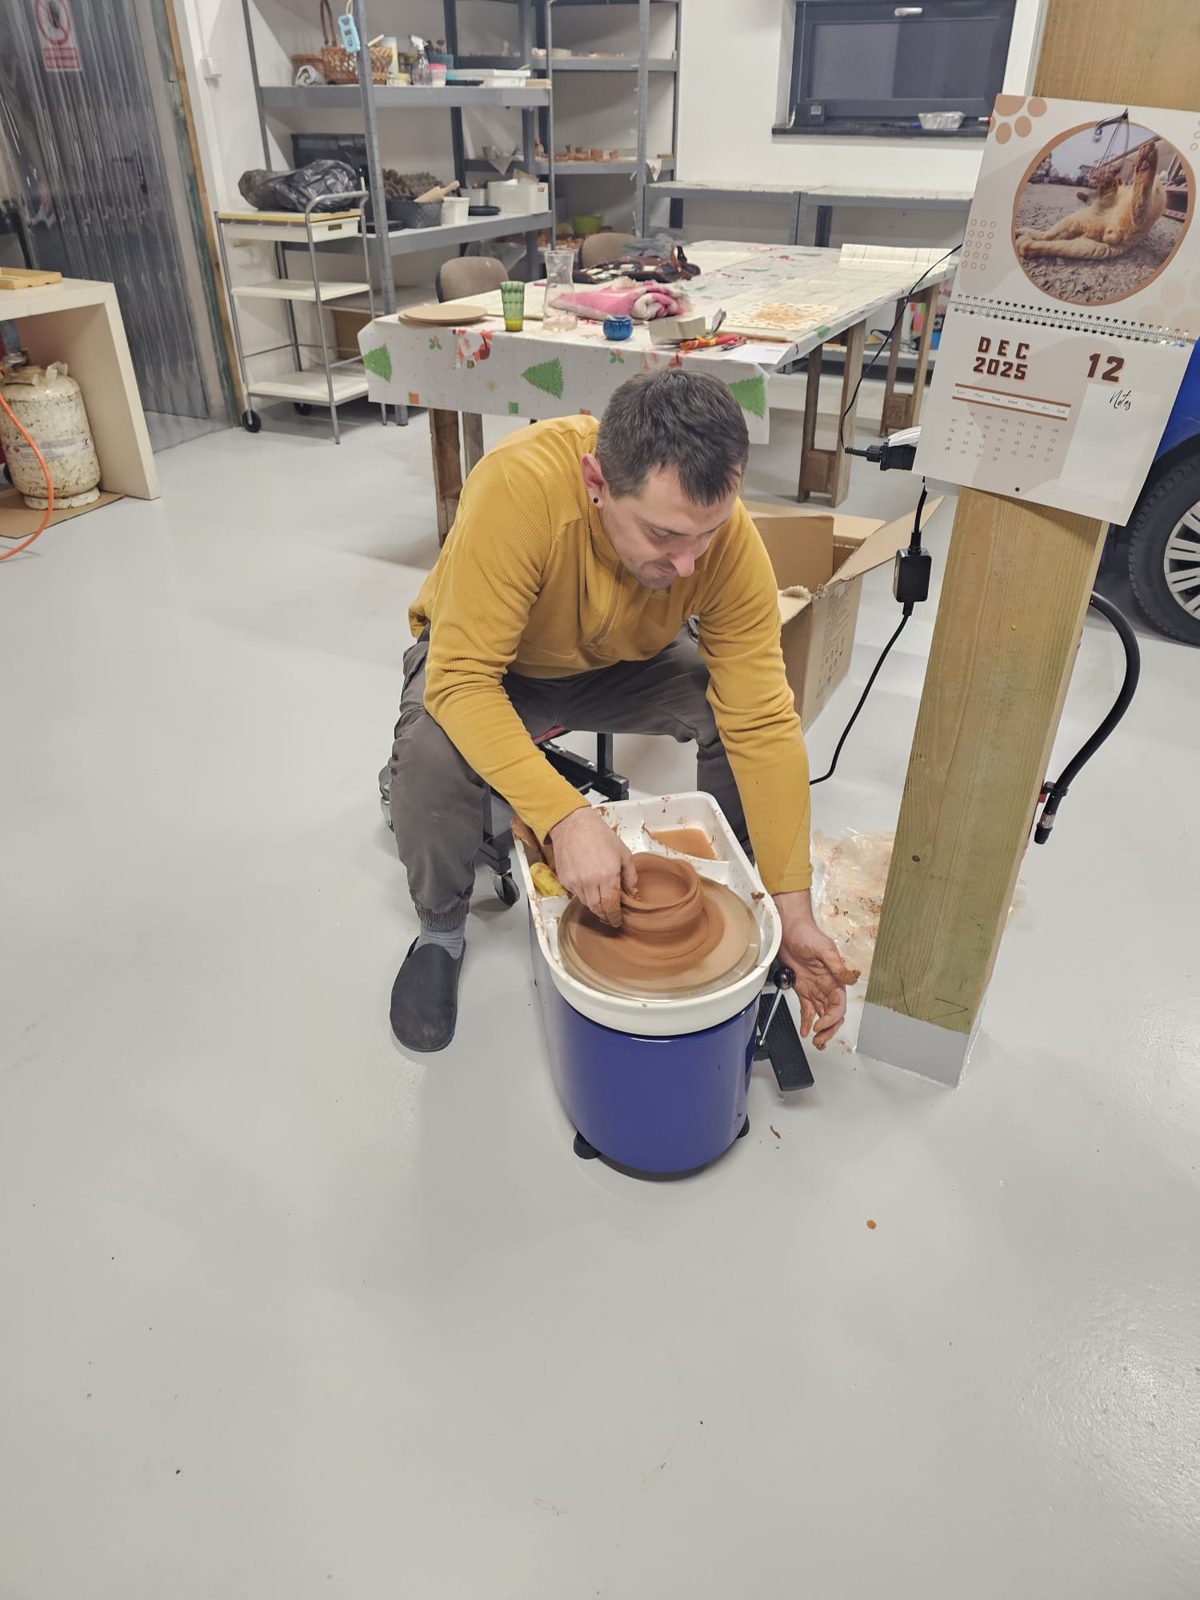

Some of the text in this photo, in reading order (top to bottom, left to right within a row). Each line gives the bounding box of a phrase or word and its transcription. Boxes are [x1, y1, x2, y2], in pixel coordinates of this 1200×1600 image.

[977, 336, 1030, 360] DEC
[972, 356, 1028, 380] 2025
[1087, 353, 1125, 383] 12
[1108, 389, 1132, 411] Notes
